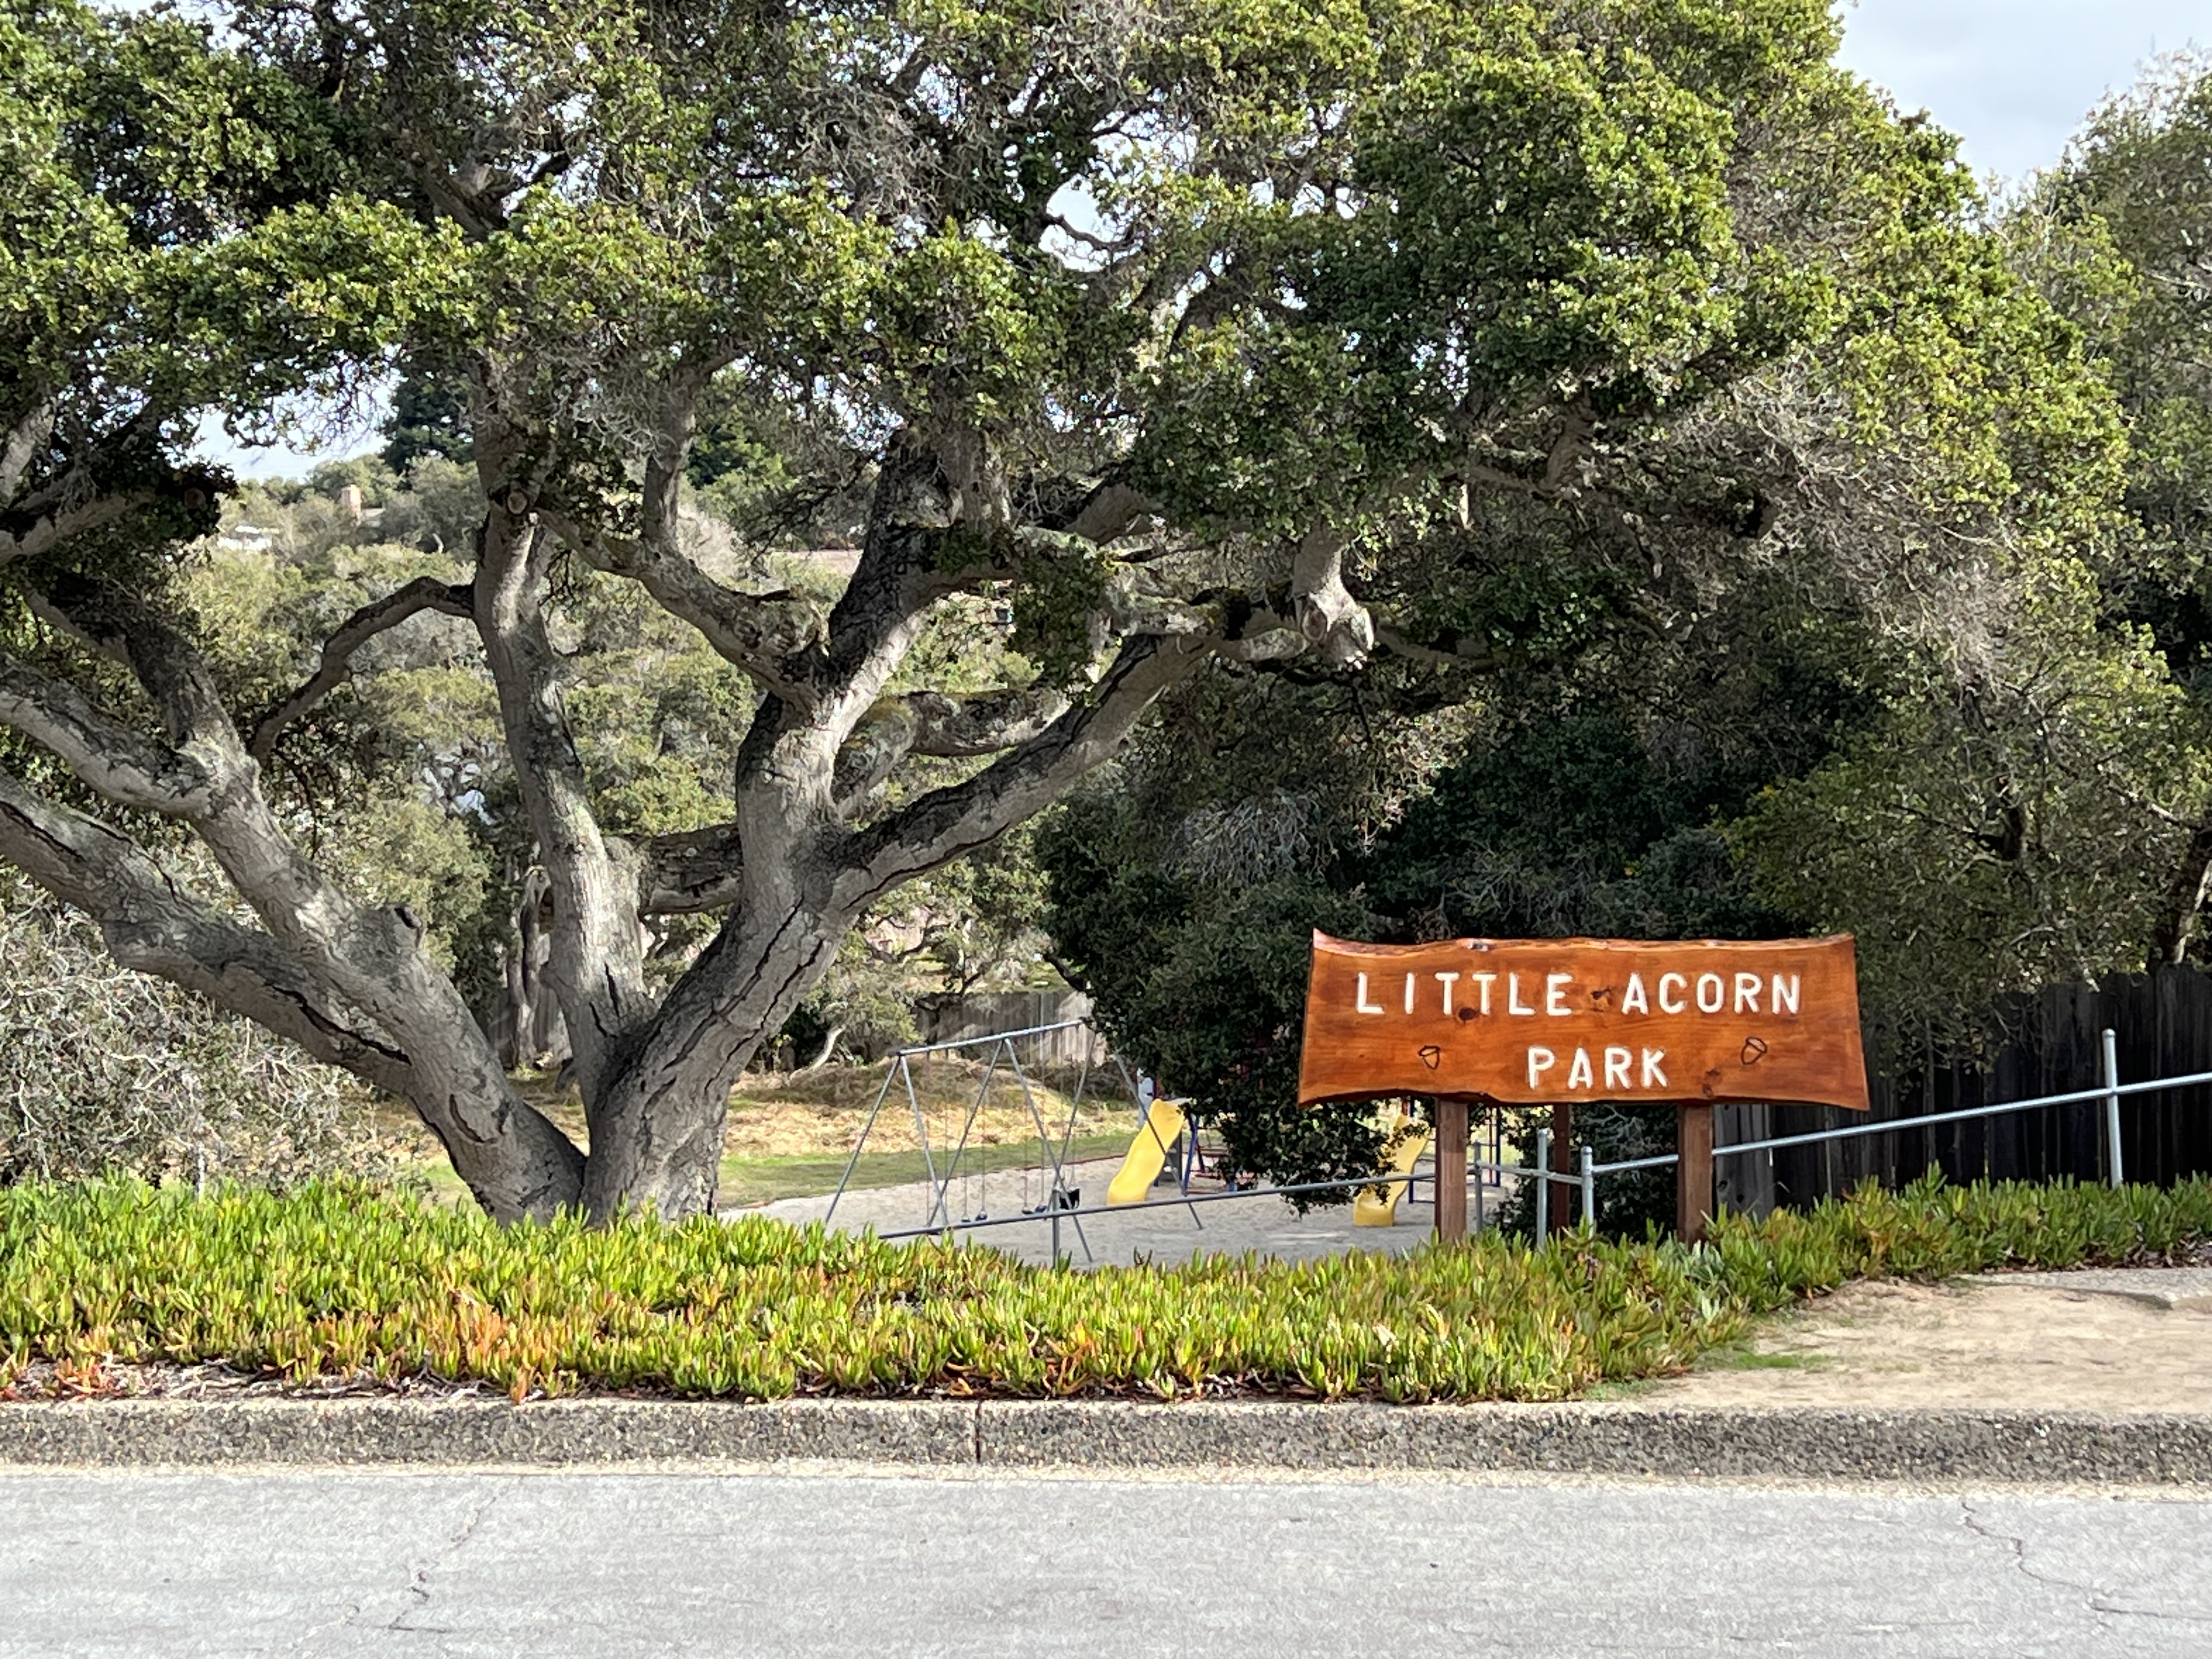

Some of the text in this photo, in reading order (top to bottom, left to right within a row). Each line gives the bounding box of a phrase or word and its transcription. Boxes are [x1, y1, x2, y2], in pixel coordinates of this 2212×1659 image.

[1356, 972, 1801, 1016] LITTLE ACORN
[1527, 1046, 1668, 1090] PARK
